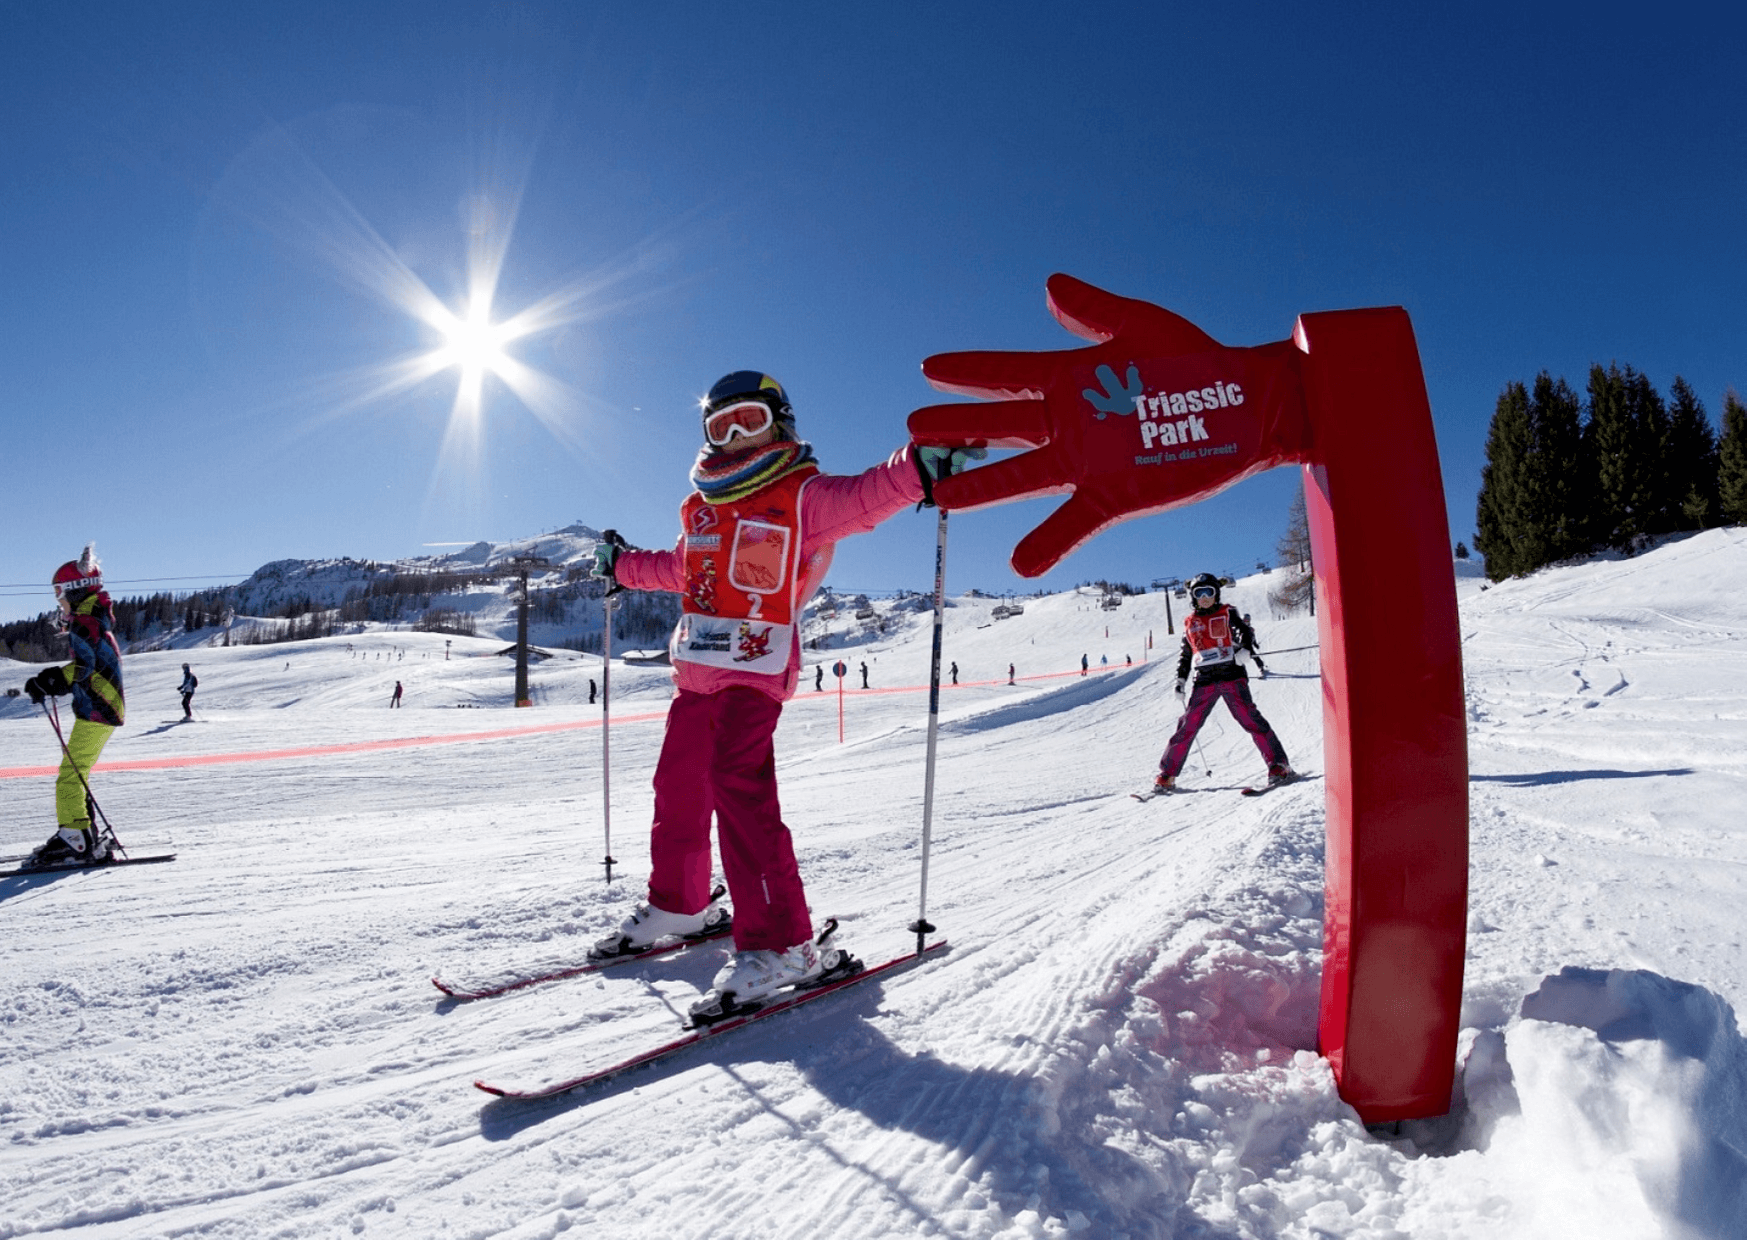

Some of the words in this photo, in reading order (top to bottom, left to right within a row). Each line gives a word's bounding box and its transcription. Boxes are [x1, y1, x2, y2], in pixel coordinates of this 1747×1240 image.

[1131, 381, 1244, 421] Triassic
[1140, 414, 1209, 449] Park
[1135, 452, 1163, 466] Rauf
[1164, 451, 1177, 462] in
[1179, 448, 1197, 460] die
[1198, 443, 1238, 458] Urzeit!
[746, 593, 764, 619] 2
